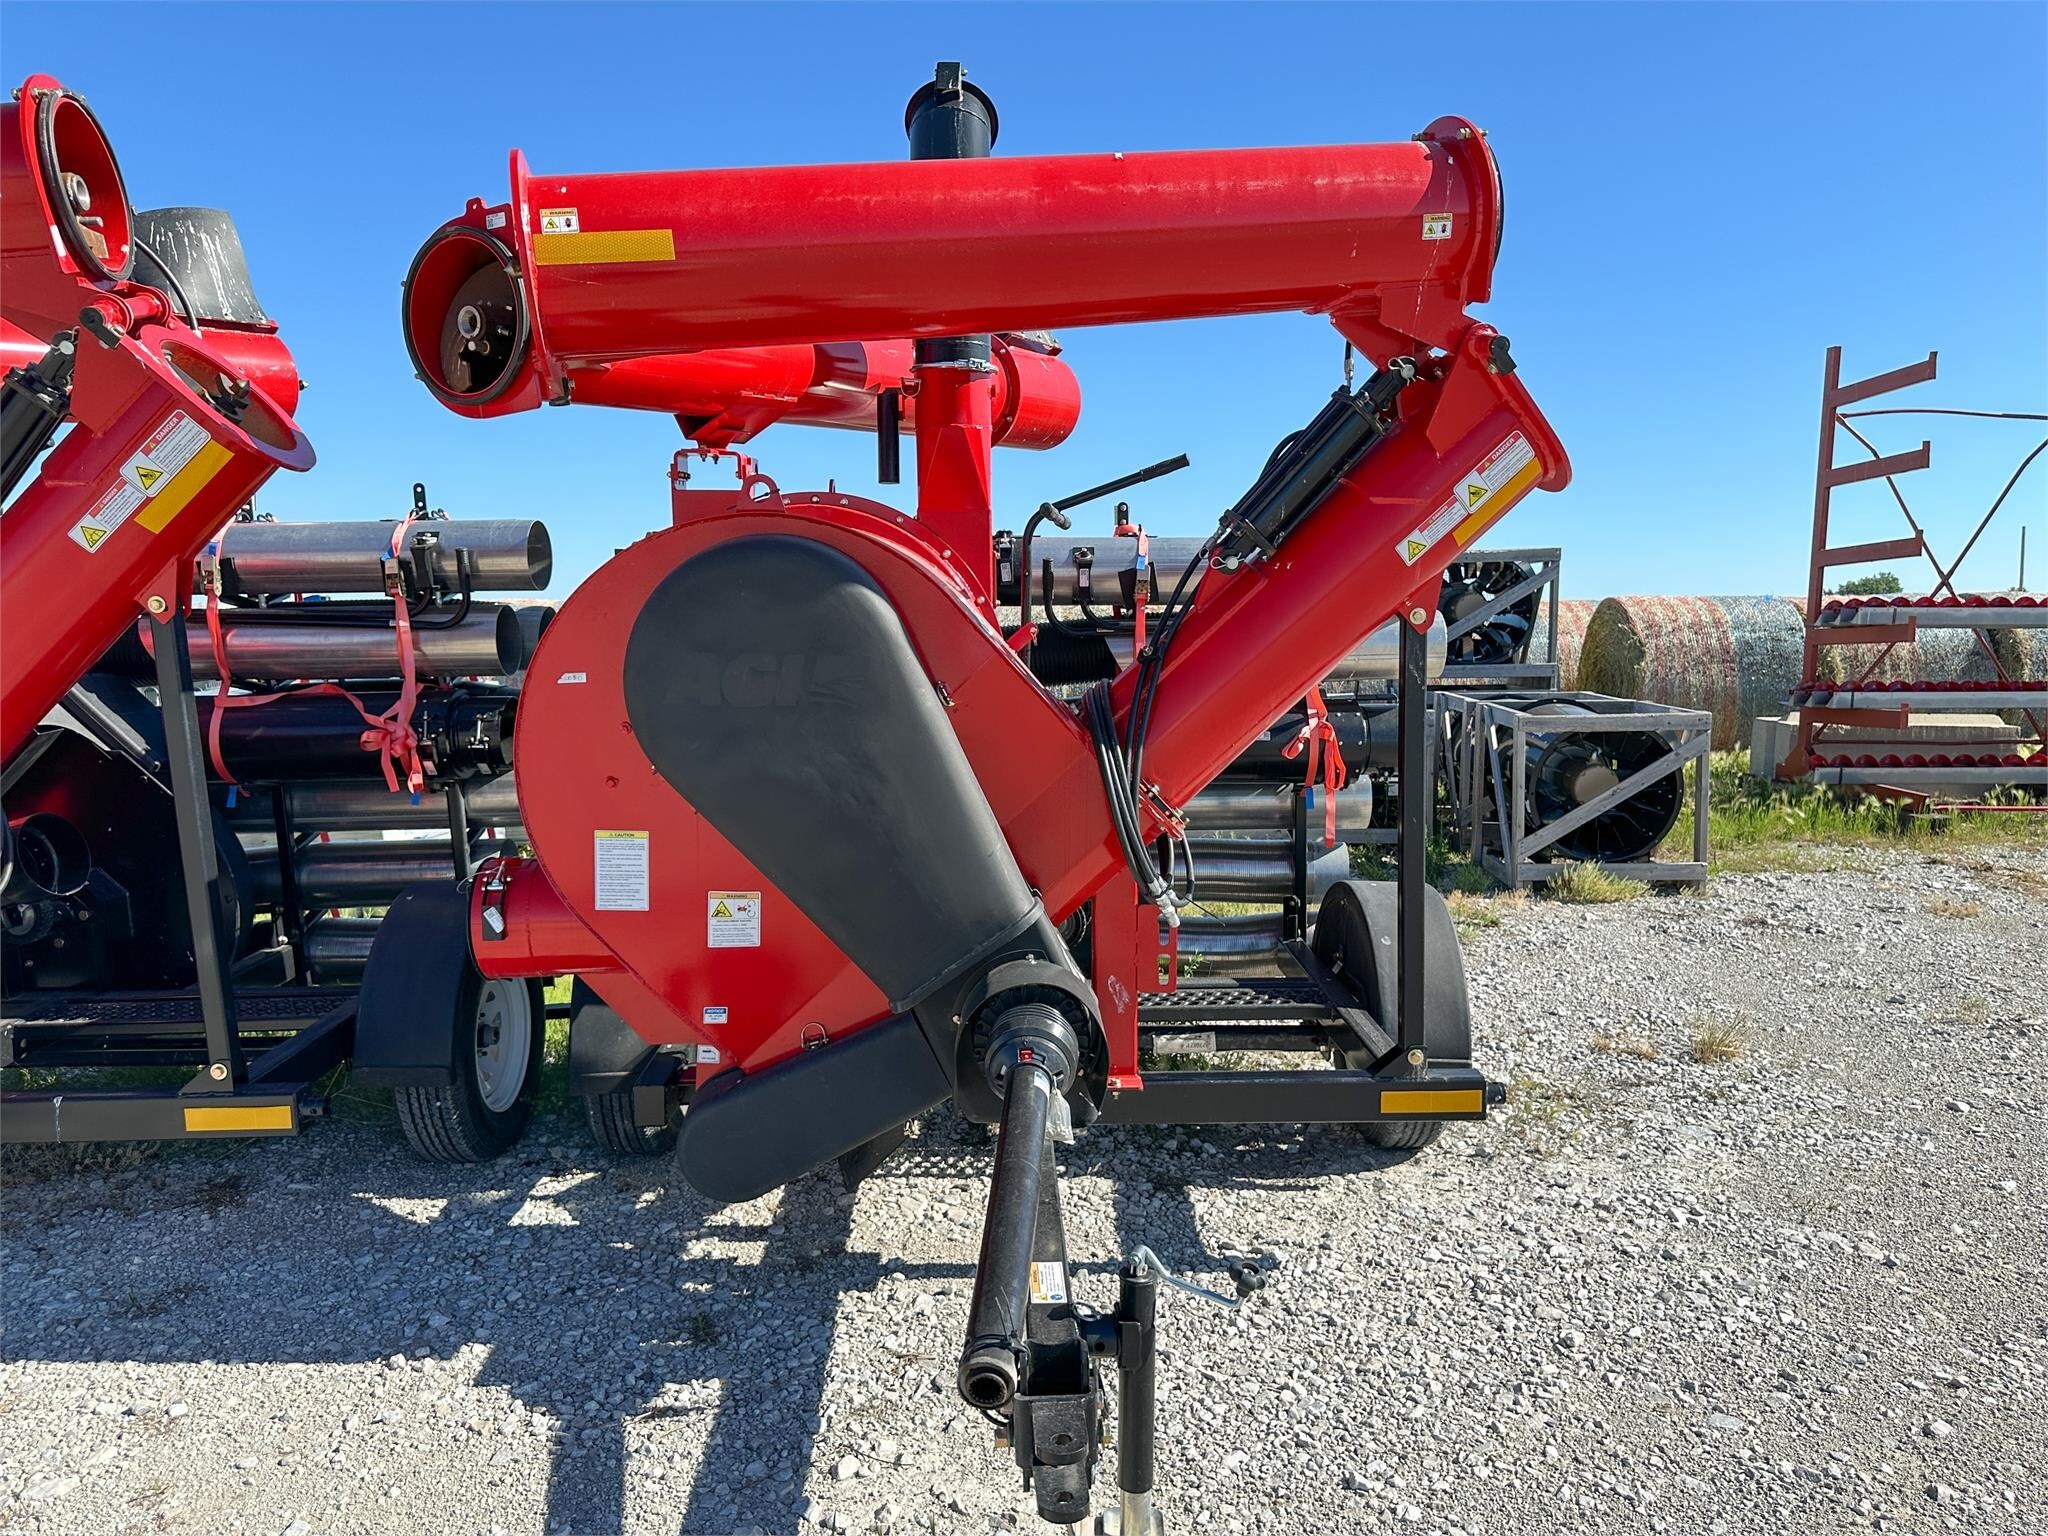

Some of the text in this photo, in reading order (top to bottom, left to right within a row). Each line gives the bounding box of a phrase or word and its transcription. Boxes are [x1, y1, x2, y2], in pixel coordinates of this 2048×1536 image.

[155, 417, 179, 441] DANGER
[1491, 438, 1515, 460] DANGER
[661, 652, 804, 706] AGI
